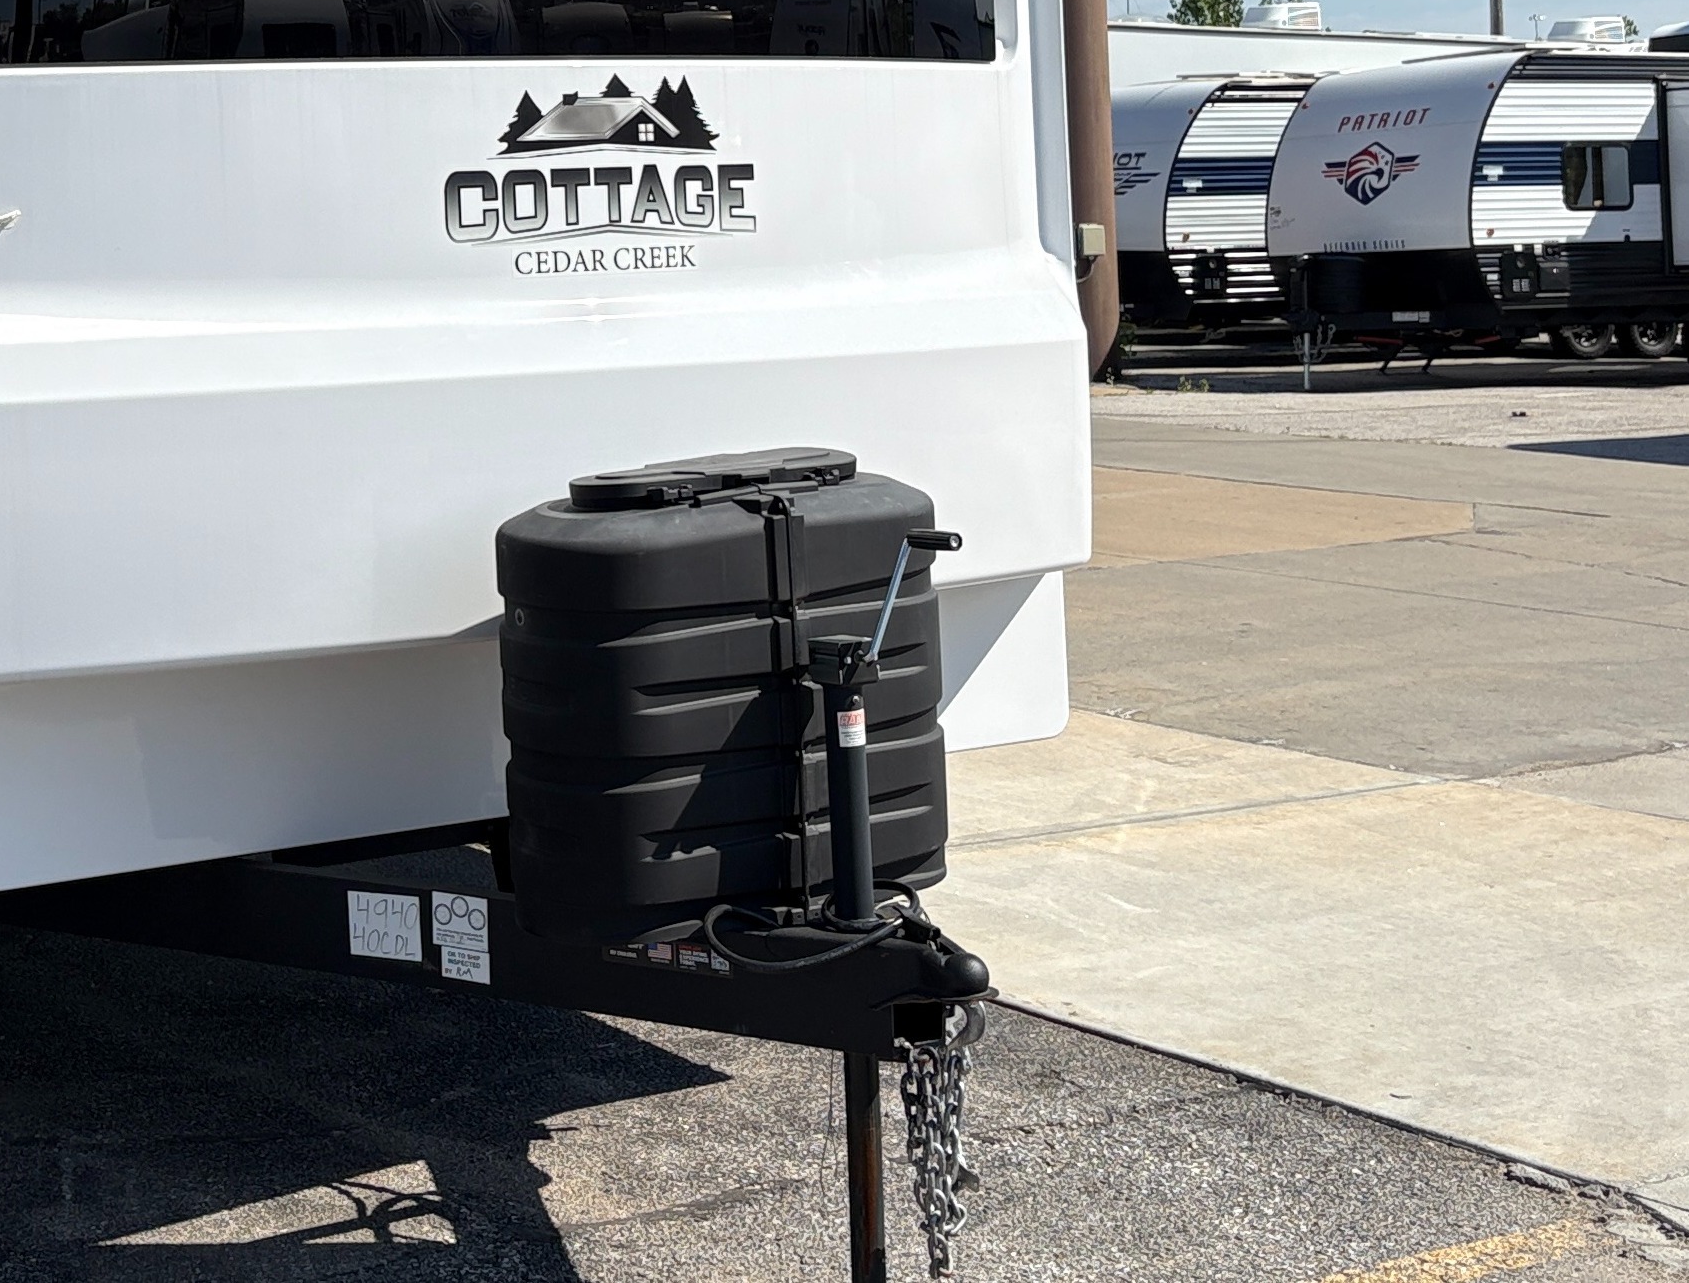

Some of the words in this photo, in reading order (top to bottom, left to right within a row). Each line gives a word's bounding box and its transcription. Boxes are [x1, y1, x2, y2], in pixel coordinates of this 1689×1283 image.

[1337, 107, 1432, 133] PATRIOT
[444, 163, 757, 244] COTTAGE
[514, 247, 609, 276] CEDAR
[613, 244, 697, 272] CREEK
[356, 893, 418, 930] 4940
[352, 922, 416, 958] 40CDL
